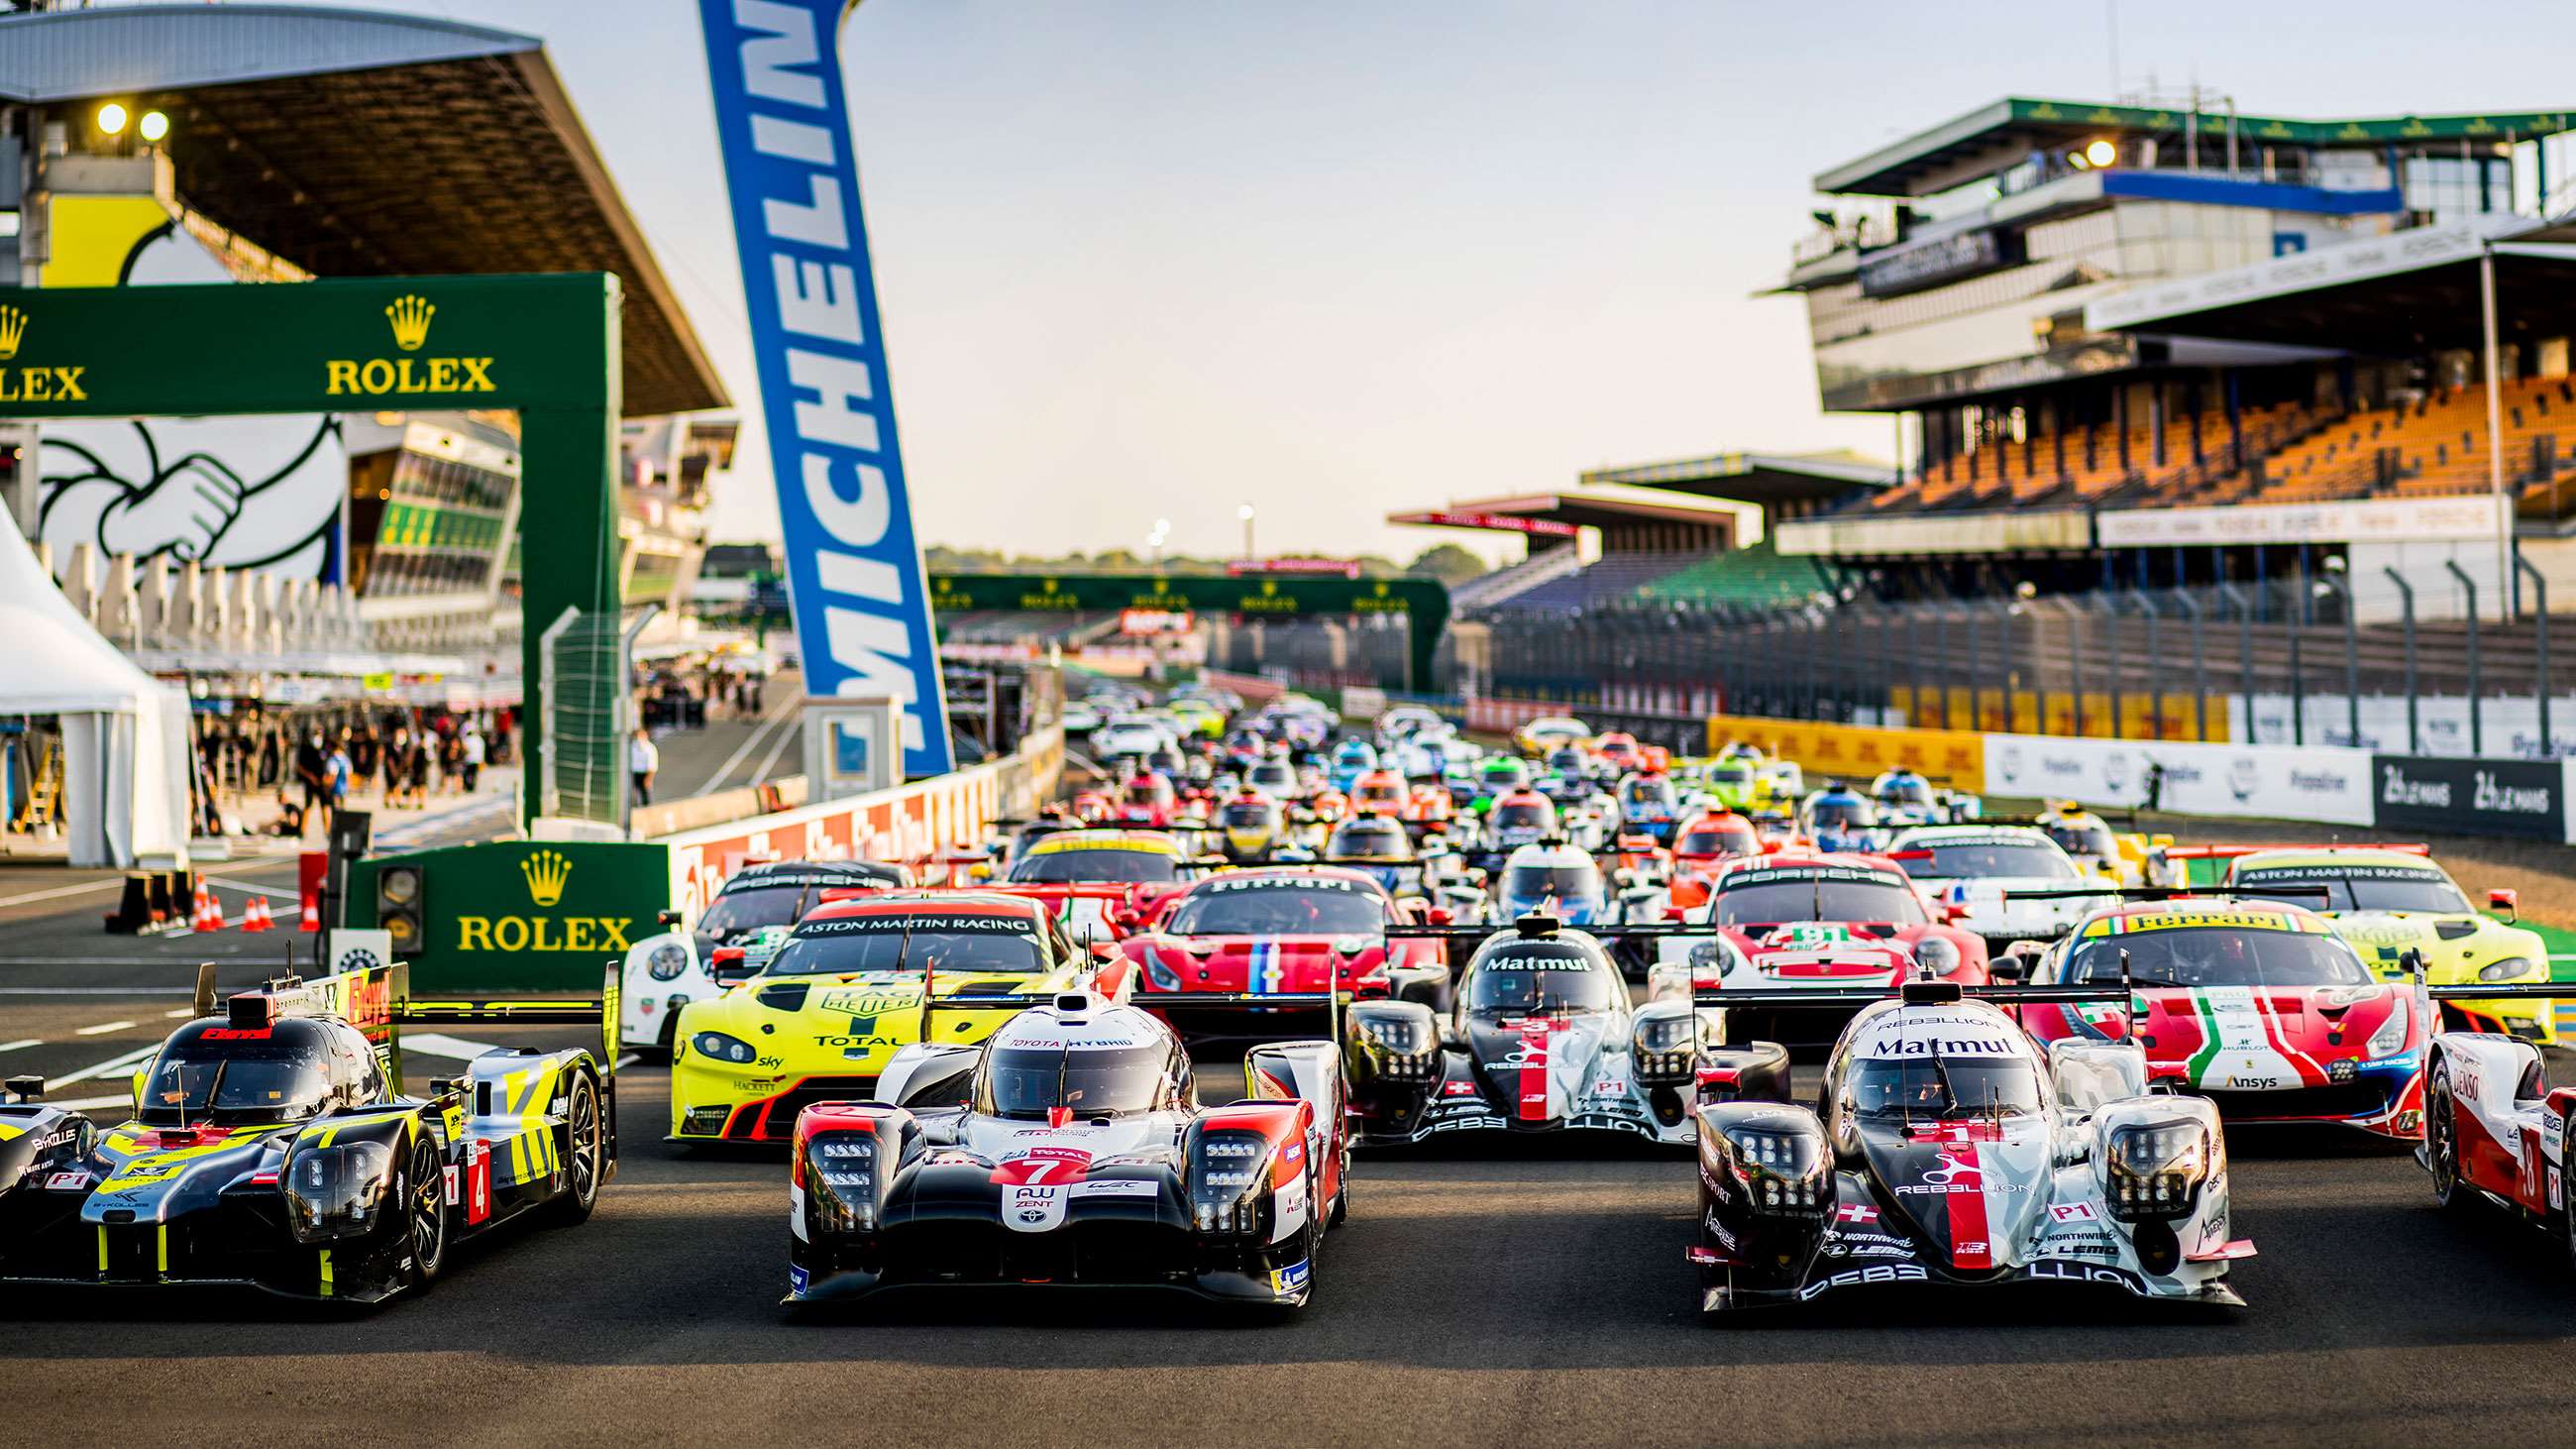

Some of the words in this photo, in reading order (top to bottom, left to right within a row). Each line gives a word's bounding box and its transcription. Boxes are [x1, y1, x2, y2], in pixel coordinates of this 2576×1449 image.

[326, 357, 496, 395] ROLEX
[0, 367, 88, 401] LEX
[1726, 867, 1902, 887] PORSCHE
[2244, 869, 2303, 881] ASTON
[2307, 867, 2373, 878] MARTIN
[2375, 867, 2443, 881] RACING
[727, 874, 895, 892] PORSCHE
[1210, 877, 1351, 892] Ferrari
[800, 919, 865, 934] ASTON
[869, 918, 947, 930] MARTIN
[952, 919, 1030, 931] RACING
[2137, 913, 2279, 929] Ferrari
[458, 916, 633, 952] ROLEX
[1485, 956, 1593, 972] Matmut
[349, 970, 390, 1026] Floyd
[827, 999, 913, 1014] HEUER
[1521, 1021, 1550, 1033] 3
[1877, 1017, 2001, 1032] REBELLION
[812, 1035, 905, 1047] TOTAL
[1010, 1039, 1060, 1048] TOYOTA
[1873, 1039, 2015, 1058] Matmut
[757, 1056, 785, 1070] sky
[1598, 1082, 1623, 1092] P1
[2225, 1073, 2278, 1090] Ansys
[2453, 1068, 2479, 1101] DENSO
[1596, 1107, 1644, 1117] LEMO
[1031, 1149, 1090, 1163] TOTAL
[52, 1173, 86, 1186] P1
[1021, 1160, 1060, 1185] 7
[476, 1164, 484, 1215] 4
[1894, 1183, 2036, 1197] REBELLION
[2548, 1173, 2560, 1204] P1
[2053, 1204, 2093, 1220] P1
[2047, 1229, 2116, 1242] NORTHWIRE
[1850, 1245, 1917, 1260] LEMO
[2058, 1245, 2119, 1256] LEMO
